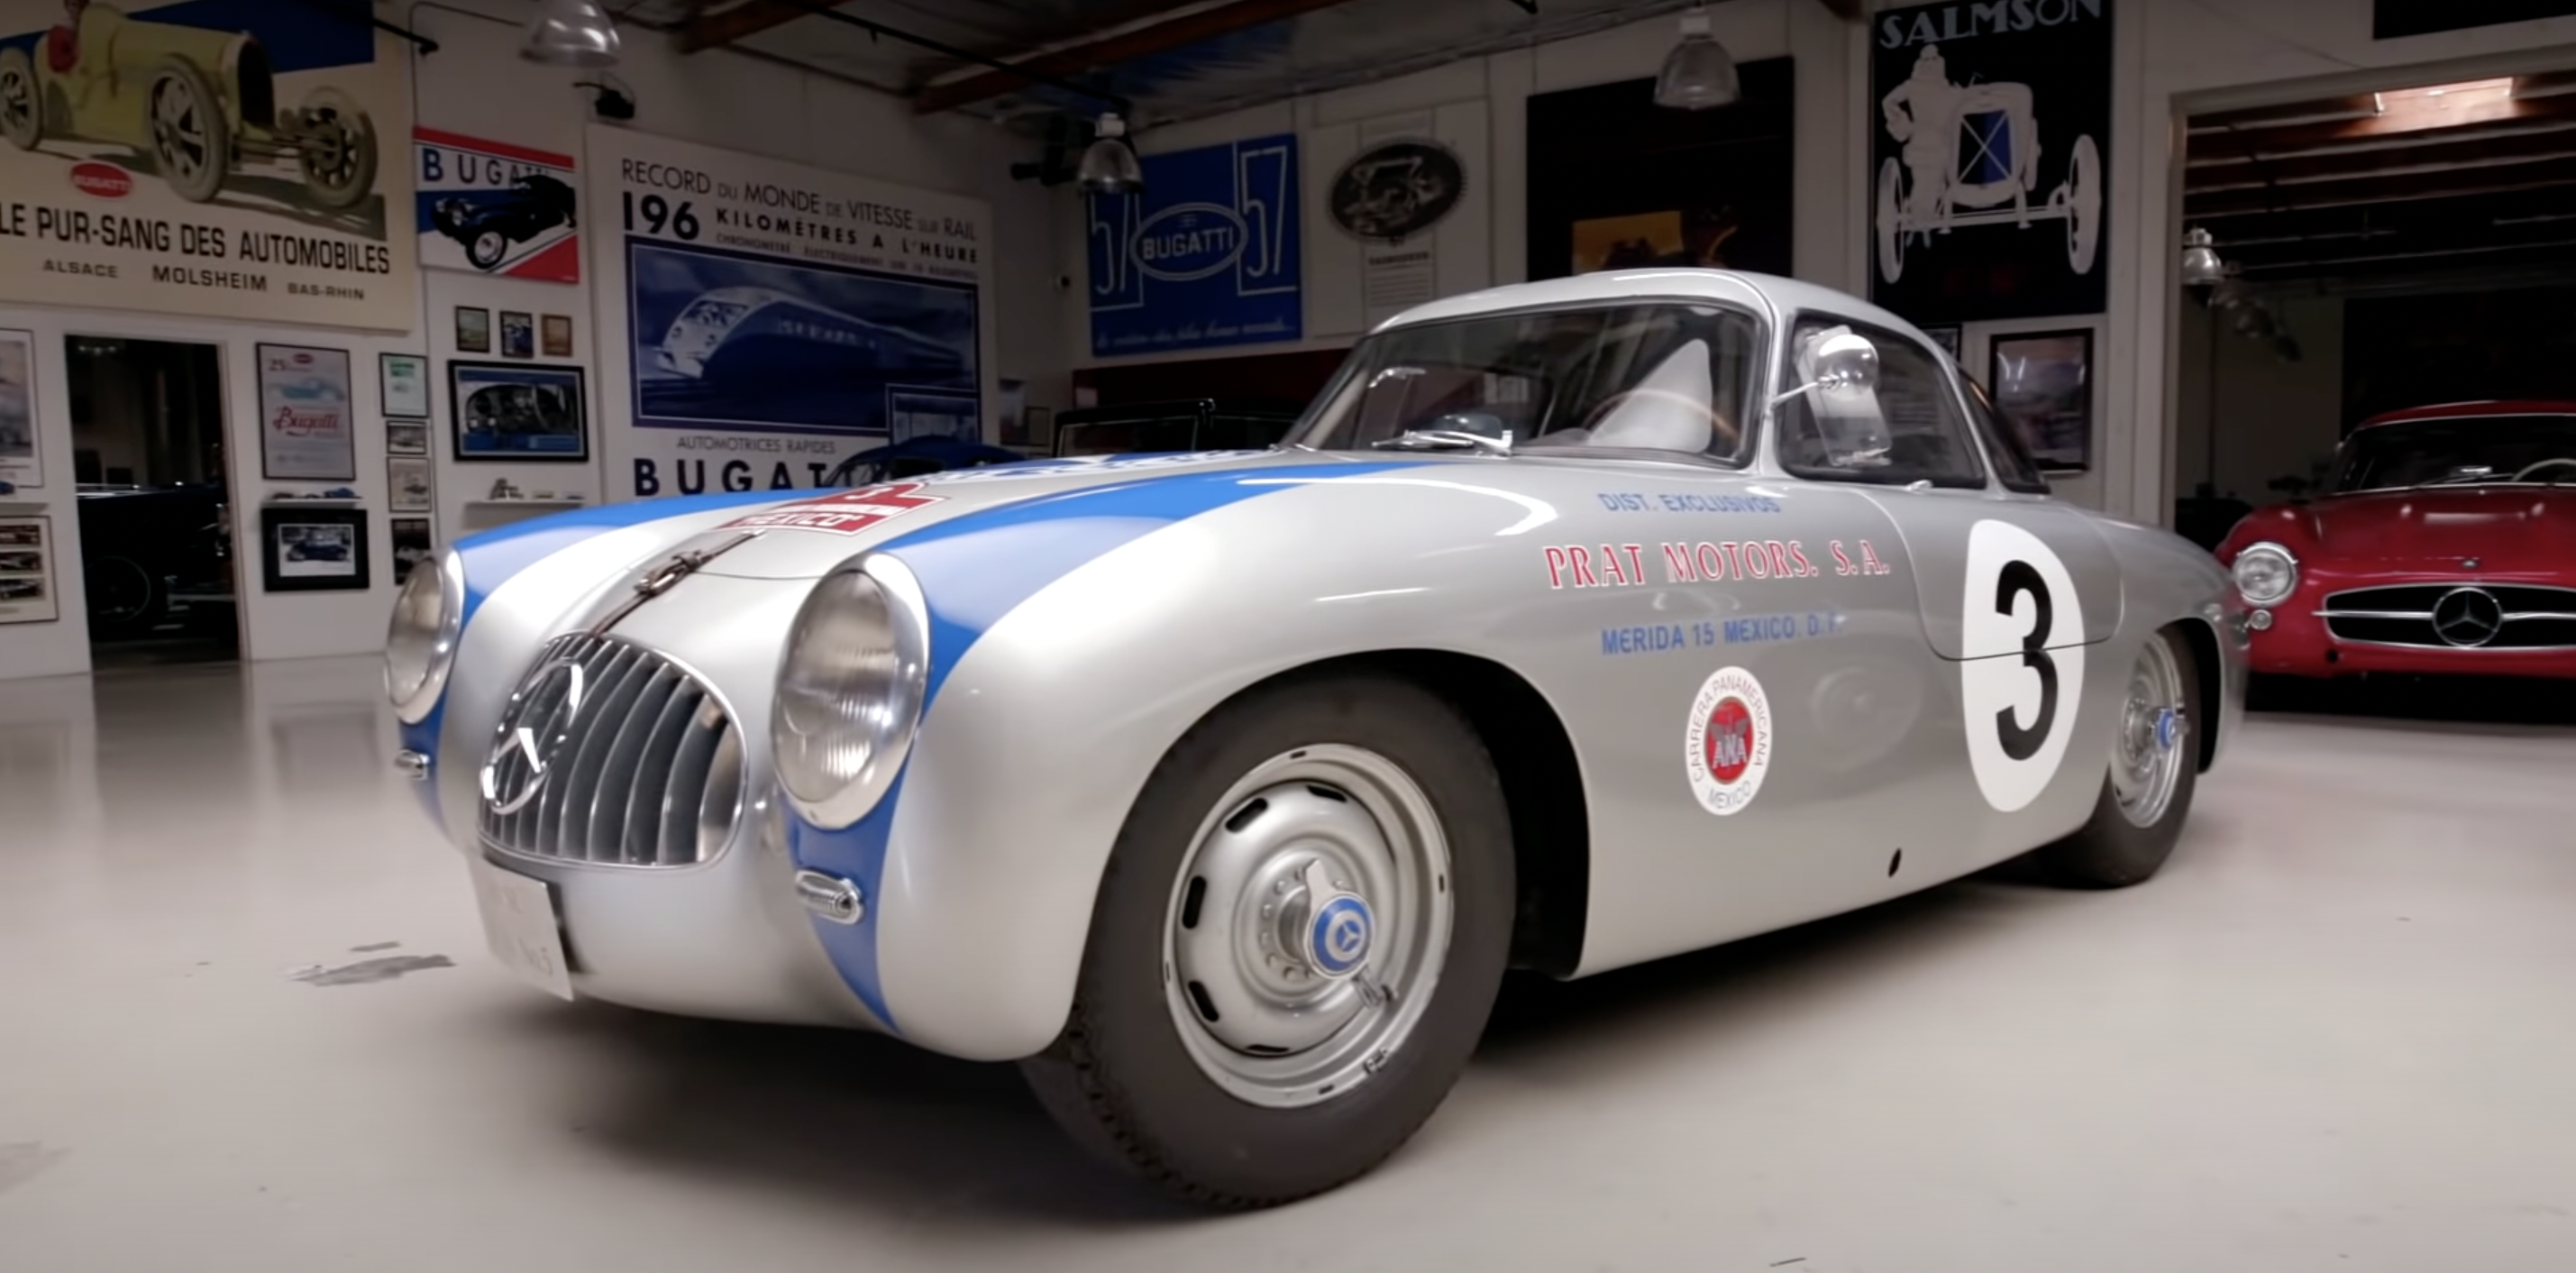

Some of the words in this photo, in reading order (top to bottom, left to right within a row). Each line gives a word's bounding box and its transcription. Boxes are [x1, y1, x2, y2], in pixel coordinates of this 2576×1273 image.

[1878, 0, 2102, 49] SALMSON
[622, 159, 711, 195] RECORD
[718, 182, 737, 200] DU
[744, 182, 820, 215] MONDE
[826, 202, 843, 217] DE
[846, 199, 912, 230] VITESSE
[944, 216, 977, 242] RAIL
[623, 192, 700, 240] 196
[1240, 145, 1288, 278] 57
[0, 202, 26, 236] LE
[37, 206, 170, 252] PUR-SANG
[181, 224, 225, 258] DES
[240, 231, 390, 273] AUTOMOBILES
[902, 234, 978, 263] L'HEURE
[1142, 226, 1235, 260] BUGATTI
[43, 259, 118, 278] ALSACE
[152, 265, 268, 291] MOLSHEIM
[288, 282, 364, 300] BAS-RHIN
[272, 406, 341, 436] Bugatti
[676, 435, 781, 453] AUTOMOTRICES
[787, 440, 836, 455] RAPIDES
[1598, 493, 1658, 512] DIST.
[1659, 494, 1781, 513] EXCLUSIVOS
[1543, 544, 1647, 590] PRAT
[1661, 541, 1818, 583] MOTORS.
[1602, 626, 1685, 655] MERIDA
[1694, 623, 1713, 646] 15
[1996, 559, 2059, 762] 3
[1689, 691, 1713, 782] CARRERA
[1713, 674, 1768, 766] PANAMERICANA
[1708, 780, 1751, 809] MEXICO
